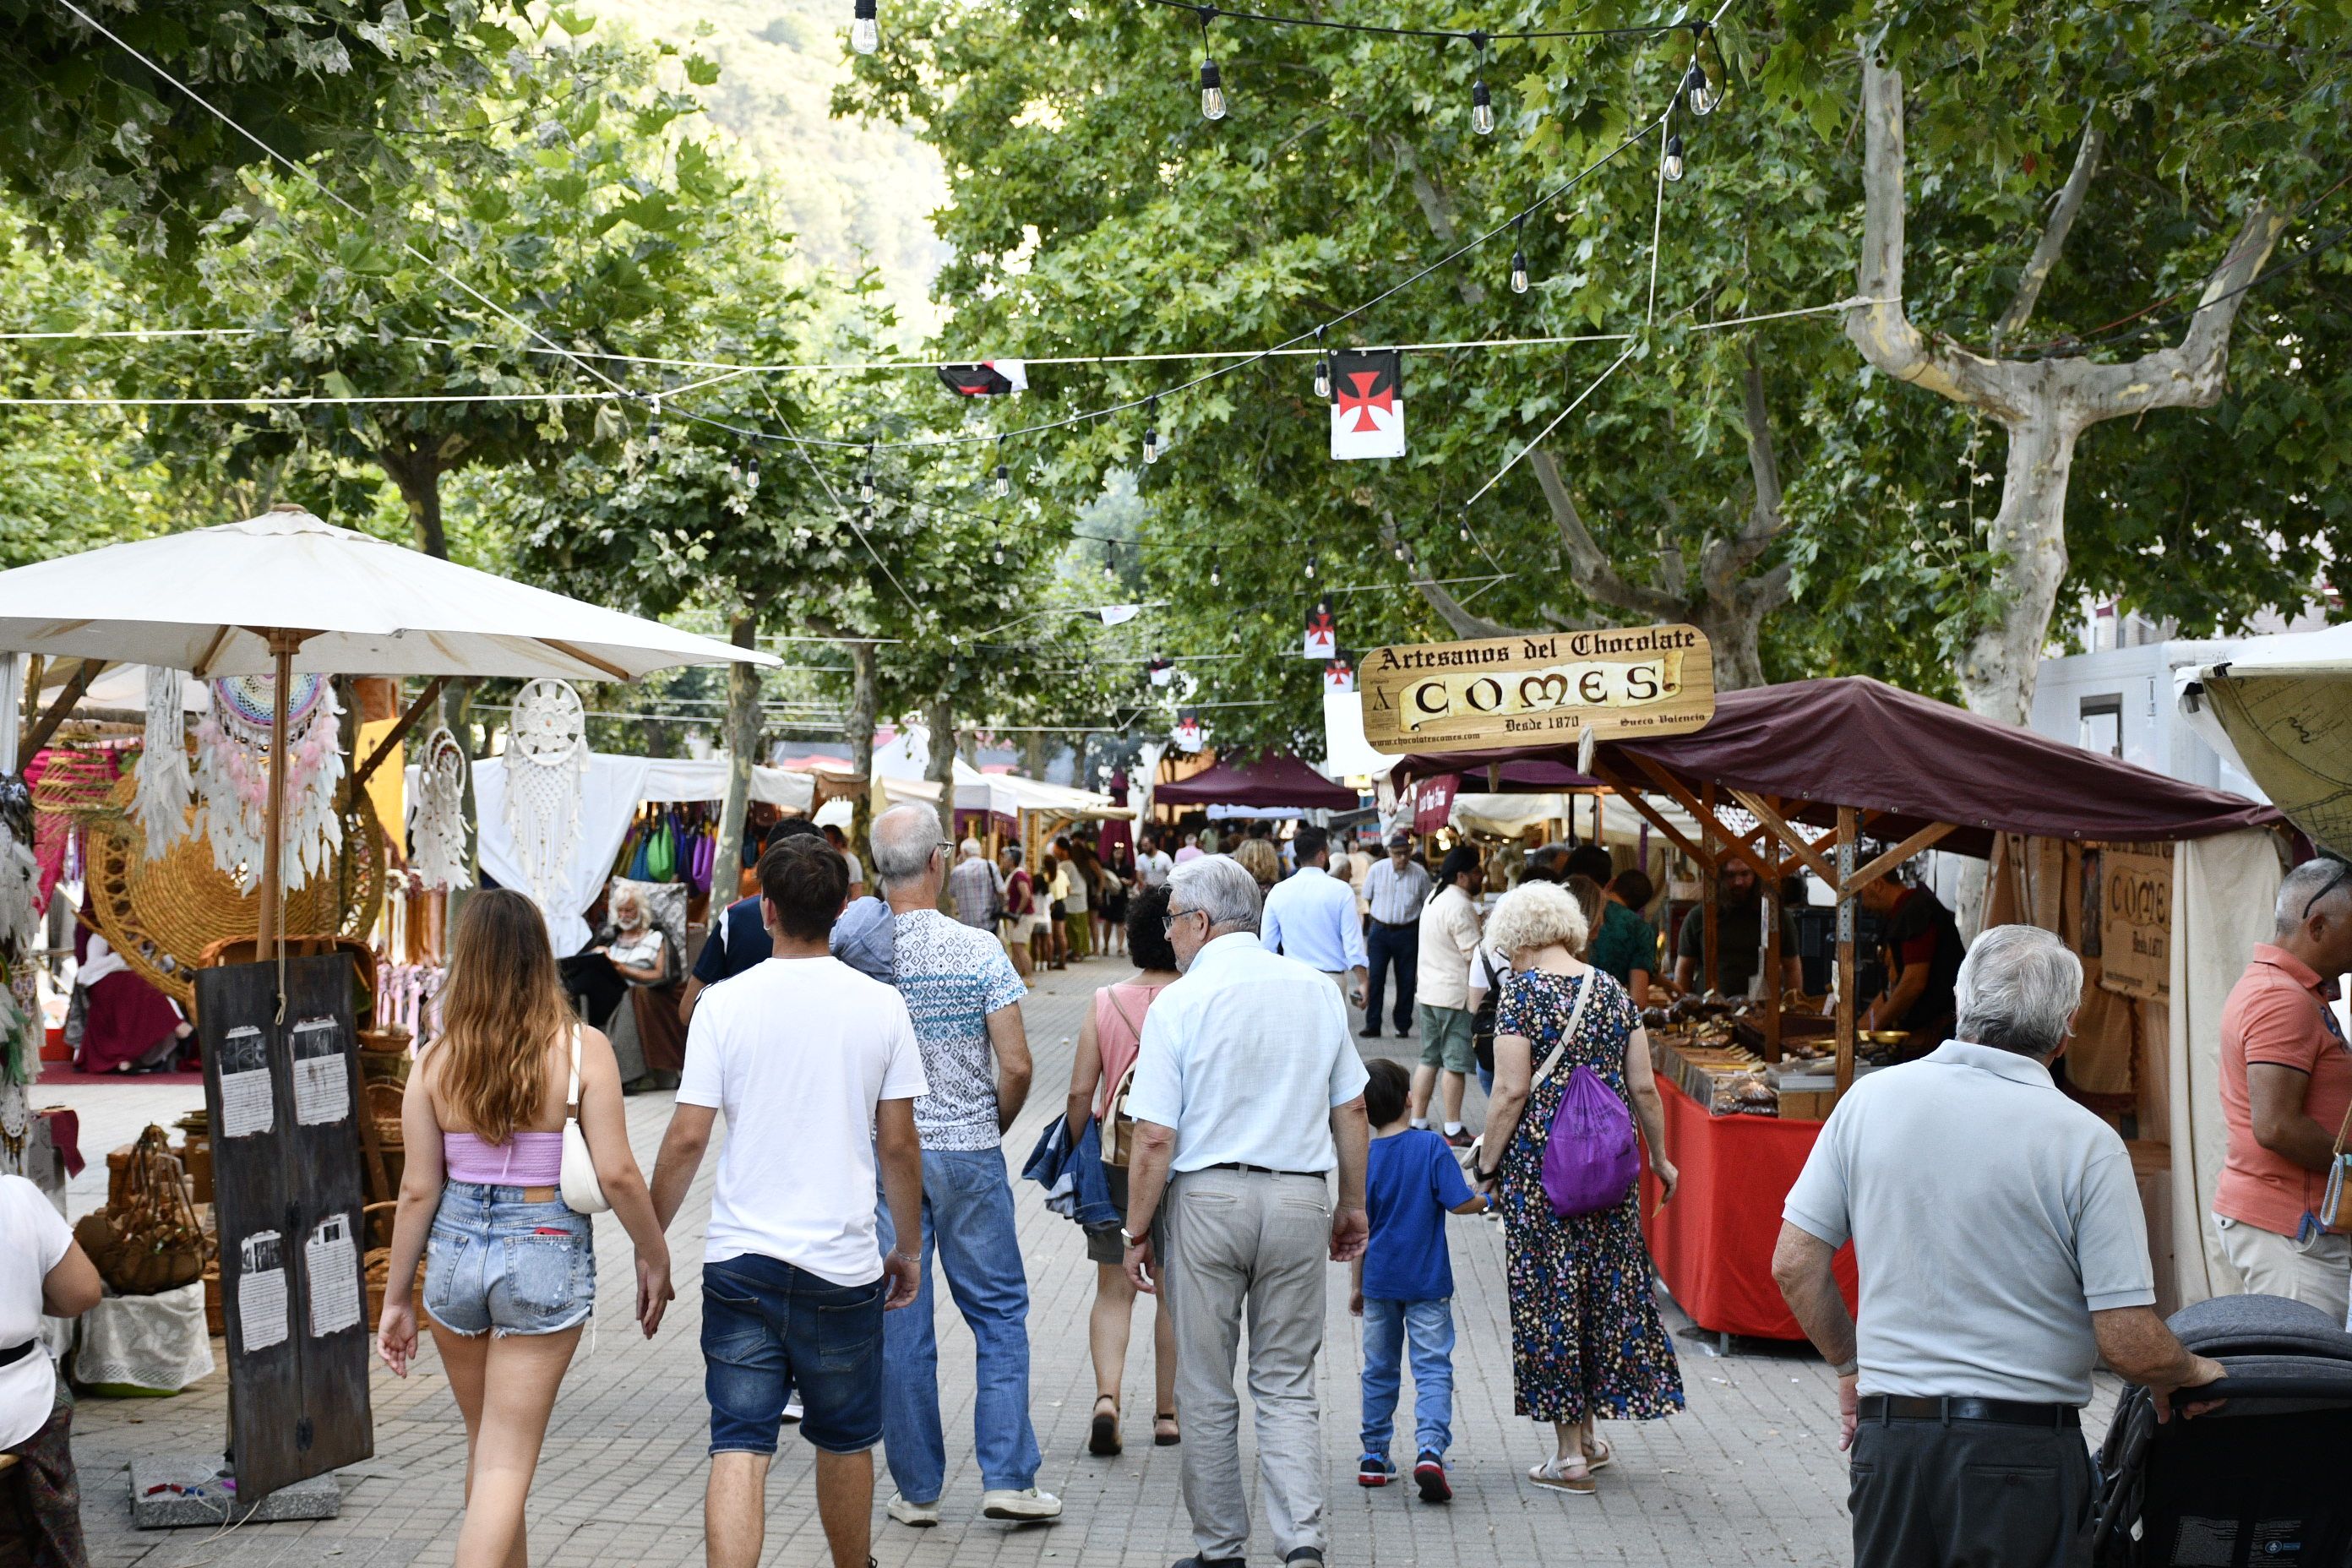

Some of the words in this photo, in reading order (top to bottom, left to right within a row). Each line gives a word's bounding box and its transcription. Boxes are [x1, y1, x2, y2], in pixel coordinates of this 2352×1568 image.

[1377, 647, 1510, 672] Artesanos
[1523, 637, 1558, 661] del
[1571, 629, 1696, 656] Chocolate
[1415, 666, 1658, 714] COMES
[1505, 717, 1543, 732] Desde
[1548, 715, 1580, 730] 1870
[1620, 716, 1654, 727] Sueca
[1658, 714, 1706, 725] Valencia
[1369, 732, 1480, 747] www.chocolatescomes.com
[2111, 874, 2172, 925] COME
